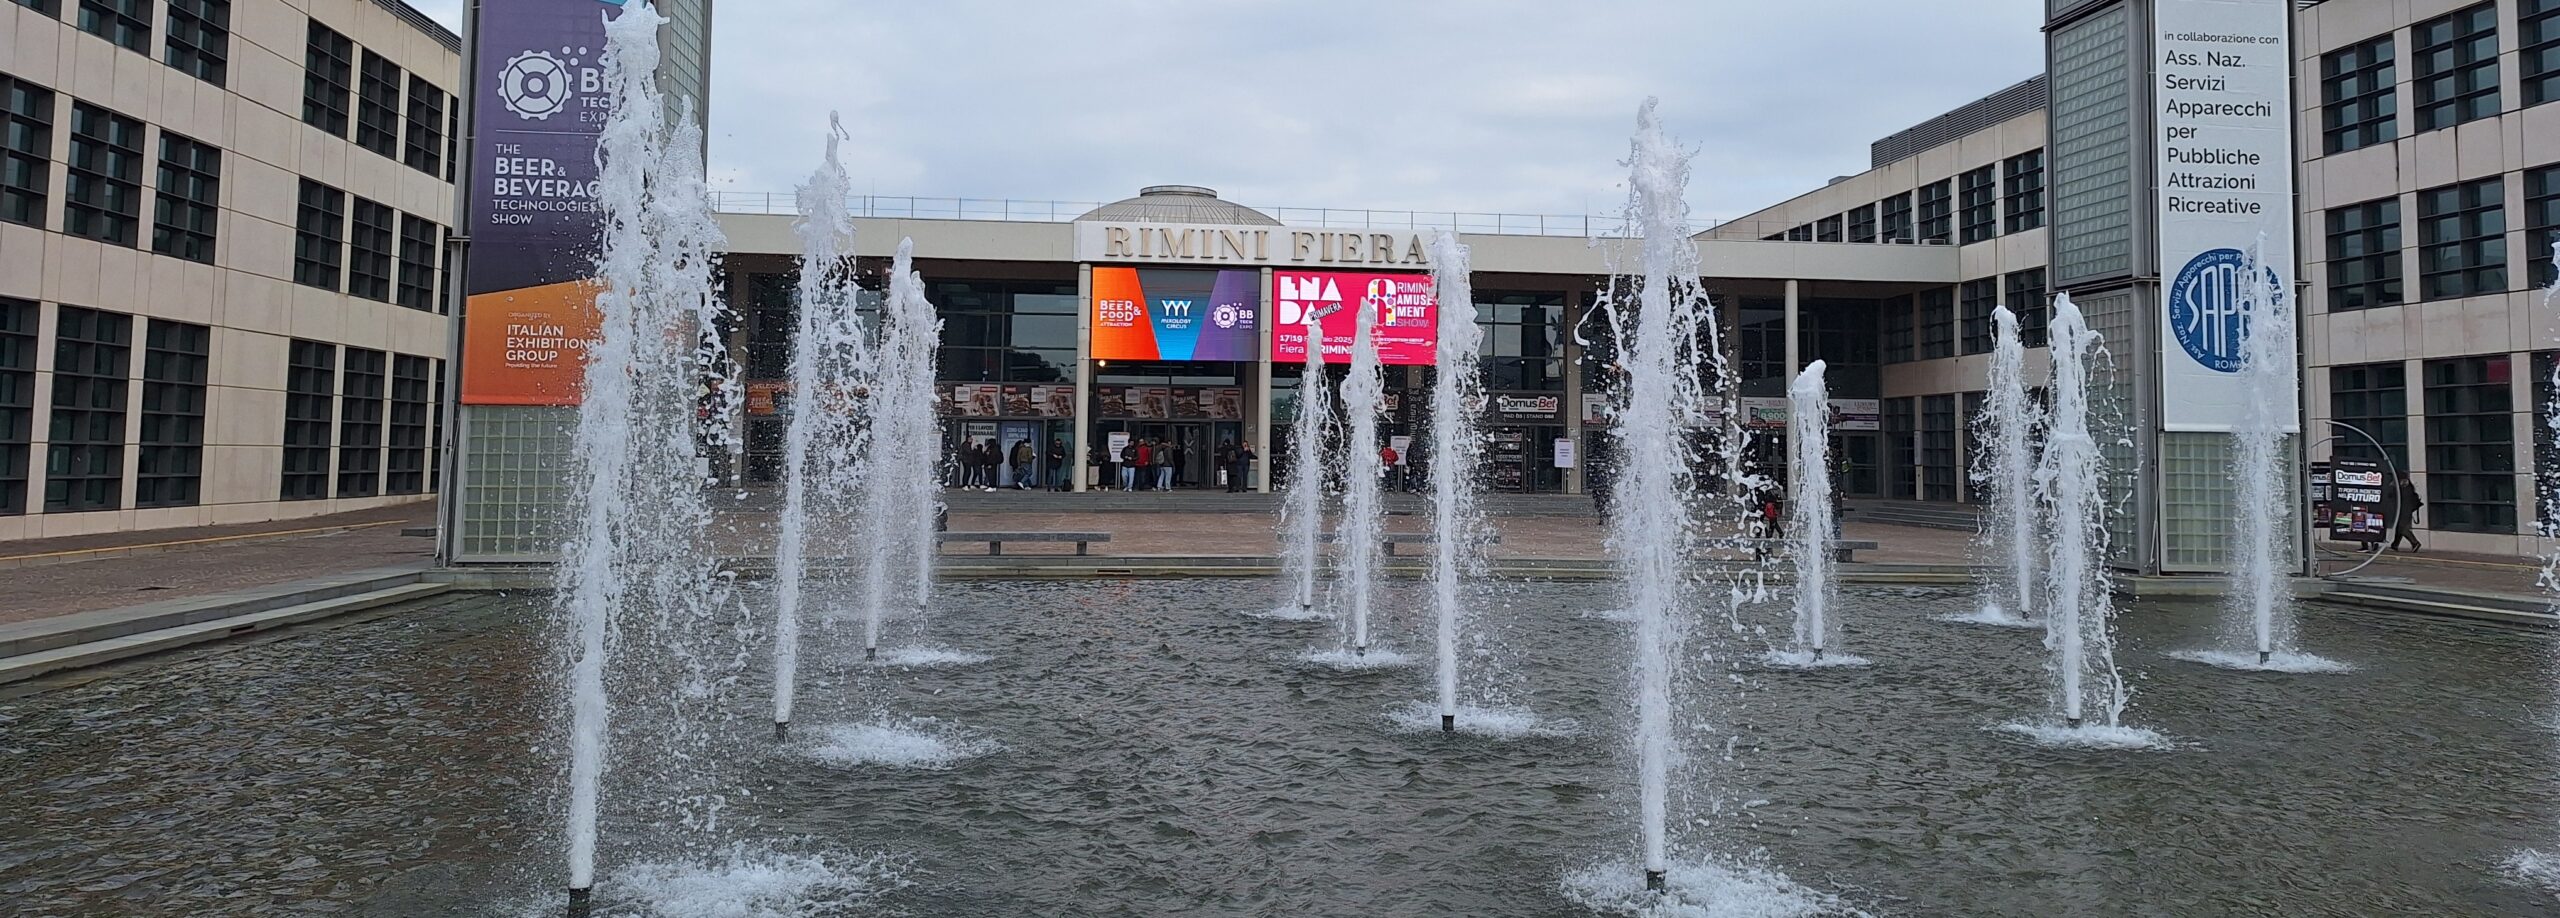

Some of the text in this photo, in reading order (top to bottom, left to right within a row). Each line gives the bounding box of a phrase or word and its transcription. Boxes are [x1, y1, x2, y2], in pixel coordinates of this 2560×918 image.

[2164, 32, 2279, 44] in collaborazione con
[2165, 50, 2246, 68] Ass. Naz.
[2166, 74, 2225, 91] Servizi
[580, 96, 610, 108] TEC
[2166, 98, 2272, 119] Apparecchi
[580, 111, 608, 122] EXP
[2166, 126, 2198, 142] per
[496, 144, 521, 154] THE
[2167, 148, 2260, 166] Pubbliche
[495, 157, 566, 176] BEER &
[2168, 173, 2256, 190] Attrazioni
[492, 200, 597, 212] TECHNOLOGIES
[2168, 197, 2261, 214] Ricreative
[492, 214, 533, 224] SHOW
[1105, 226, 1430, 264] RIMINI FIERA
[1280, 276, 1342, 301] ENA
[2172, 289, 2182, 319] Servizi
[2179, 253, 2216, 288] Apparecchi
[2219, 254, 2233, 262] per
[1100, 300, 1142, 315] BEER &
[1308, 301, 1343, 321] PRIMAVERA
[1397, 306, 1426, 317] MENT
[1100, 311, 1133, 321] FOOD
[1239, 310, 1254, 319] BB
[1397, 318, 1429, 327] SHOW
[507, 324, 564, 337] ITALIAN
[506, 338, 590, 350] EXHIBITION
[1280, 344, 1304, 354] Fiera
[506, 350, 558, 361] GROUP
[1502, 398, 1556, 408] DomusBet
[2338, 472, 2380, 482] DomusBet
[2347, 494, 2381, 502] FUTURO
